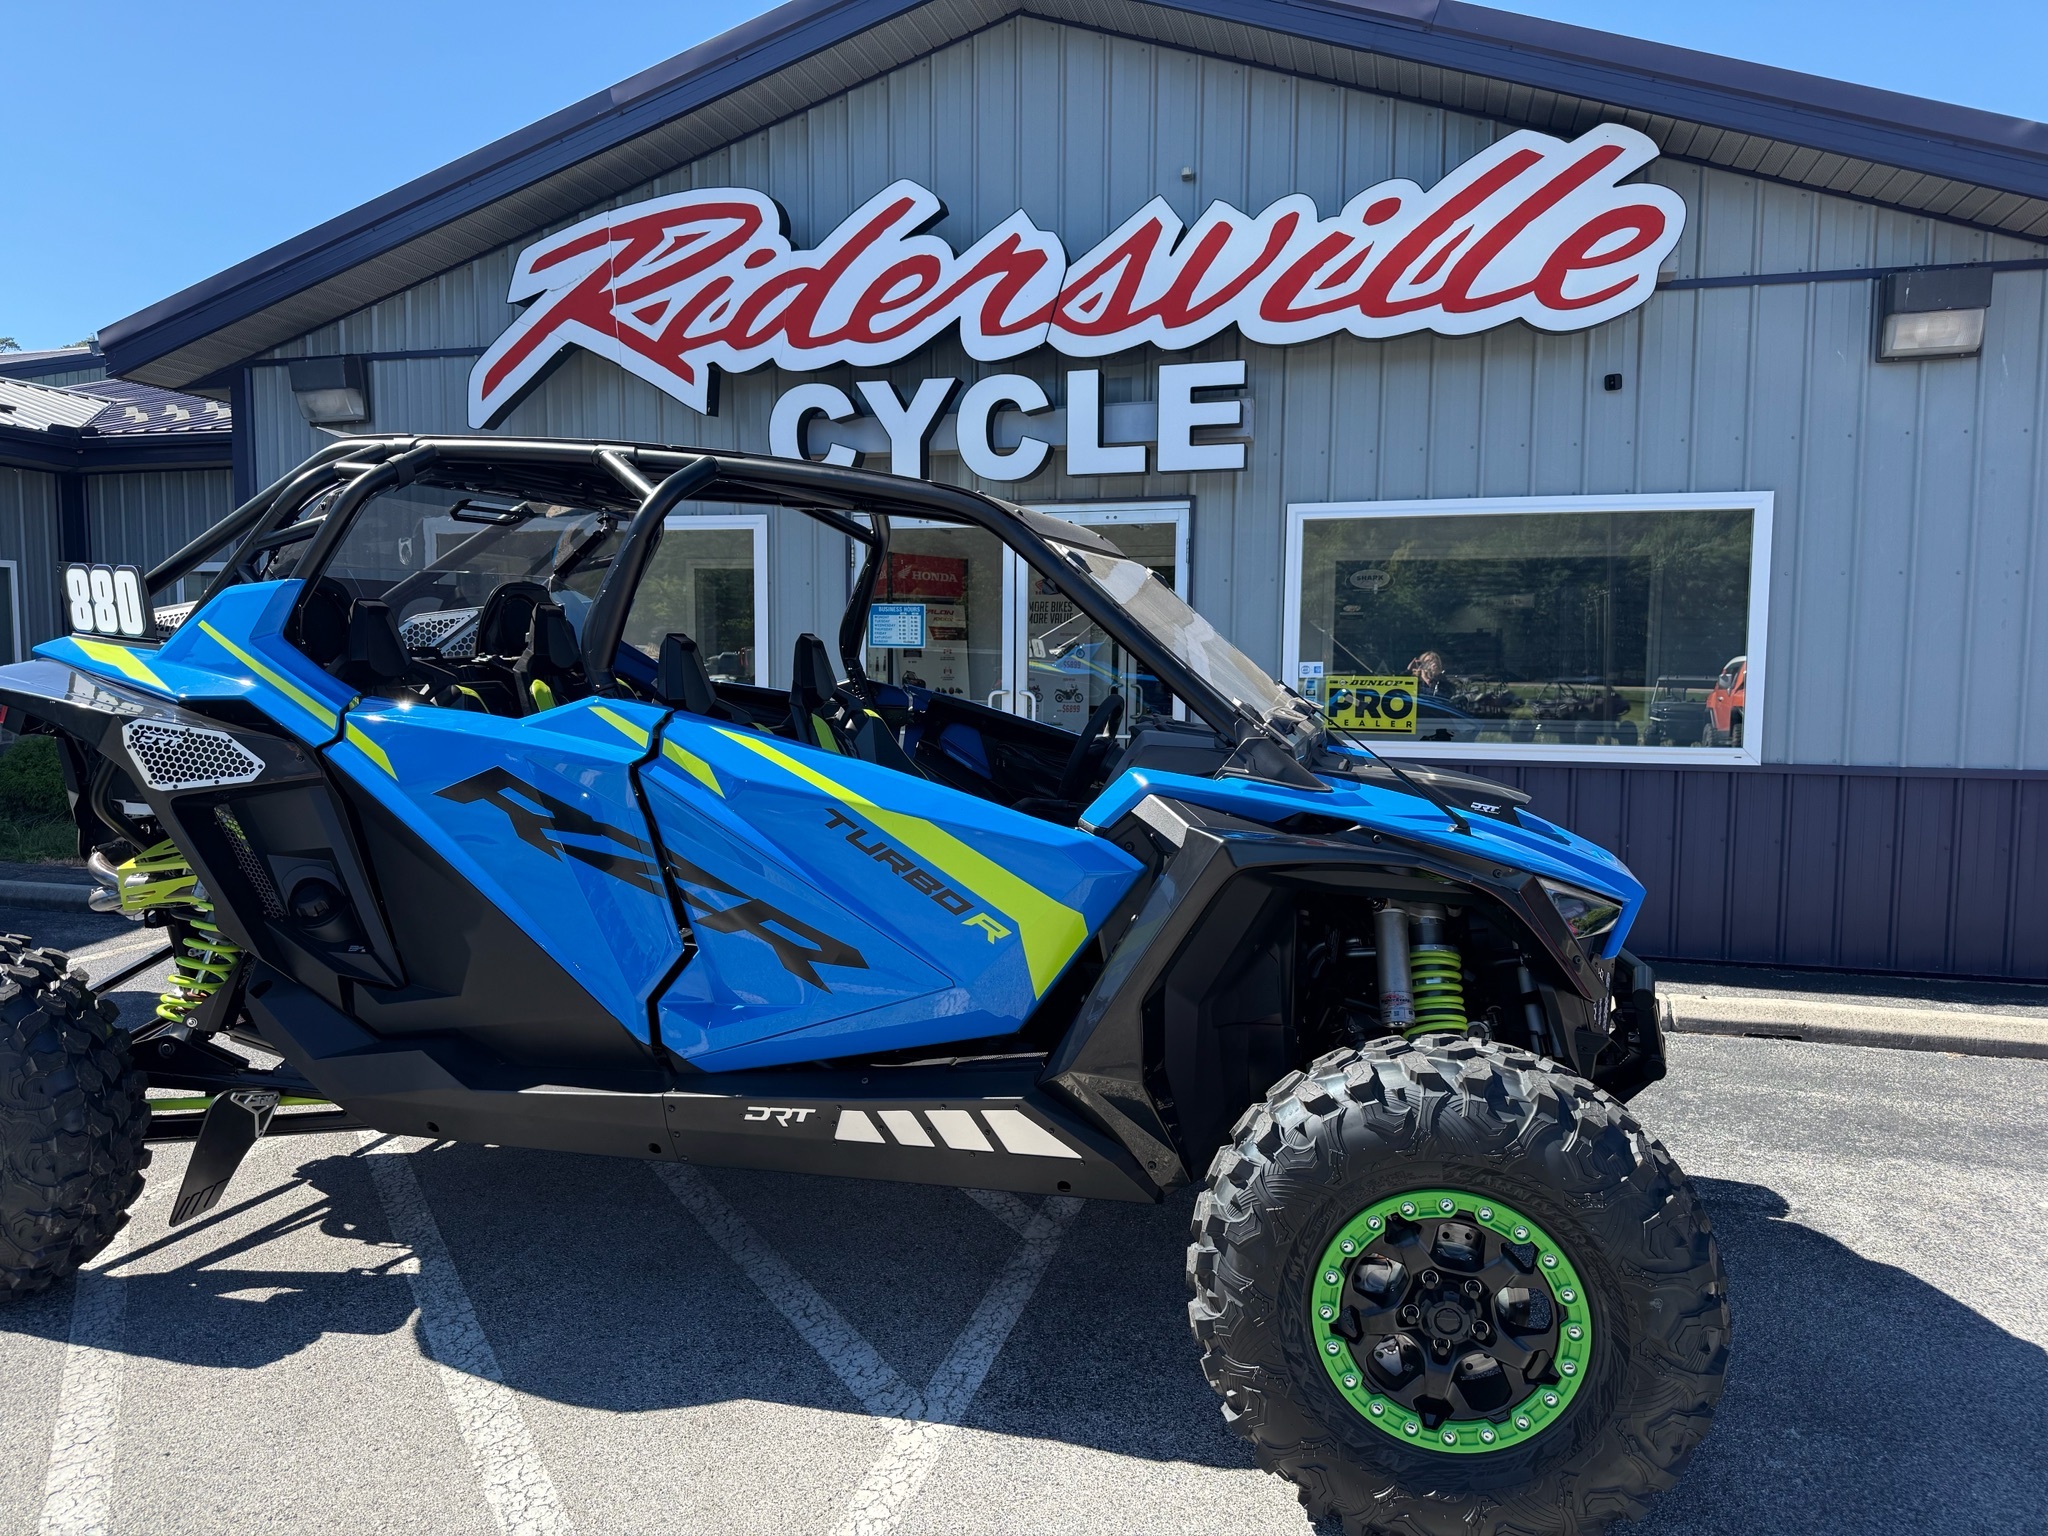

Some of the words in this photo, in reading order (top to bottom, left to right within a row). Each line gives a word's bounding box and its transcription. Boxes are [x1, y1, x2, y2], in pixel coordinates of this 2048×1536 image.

[480, 142, 1668, 404] Ridersville
[769, 360, 1247, 481] CYCLE
[911, 570, 958, 583] HONDA
[66, 563, 147, 637] 880
[1050, 601, 1073, 613] BIKES
[1049, 613, 1073, 624] VALUE
[1349, 679, 1403, 687] DUNLOP
[1328, 688, 1414, 719] PRO
[1328, 719, 1412, 728] DEALER
[824, 808, 974, 916] TURBO
[961, 912, 1012, 945] R
[744, 1106, 817, 1128] DRT
